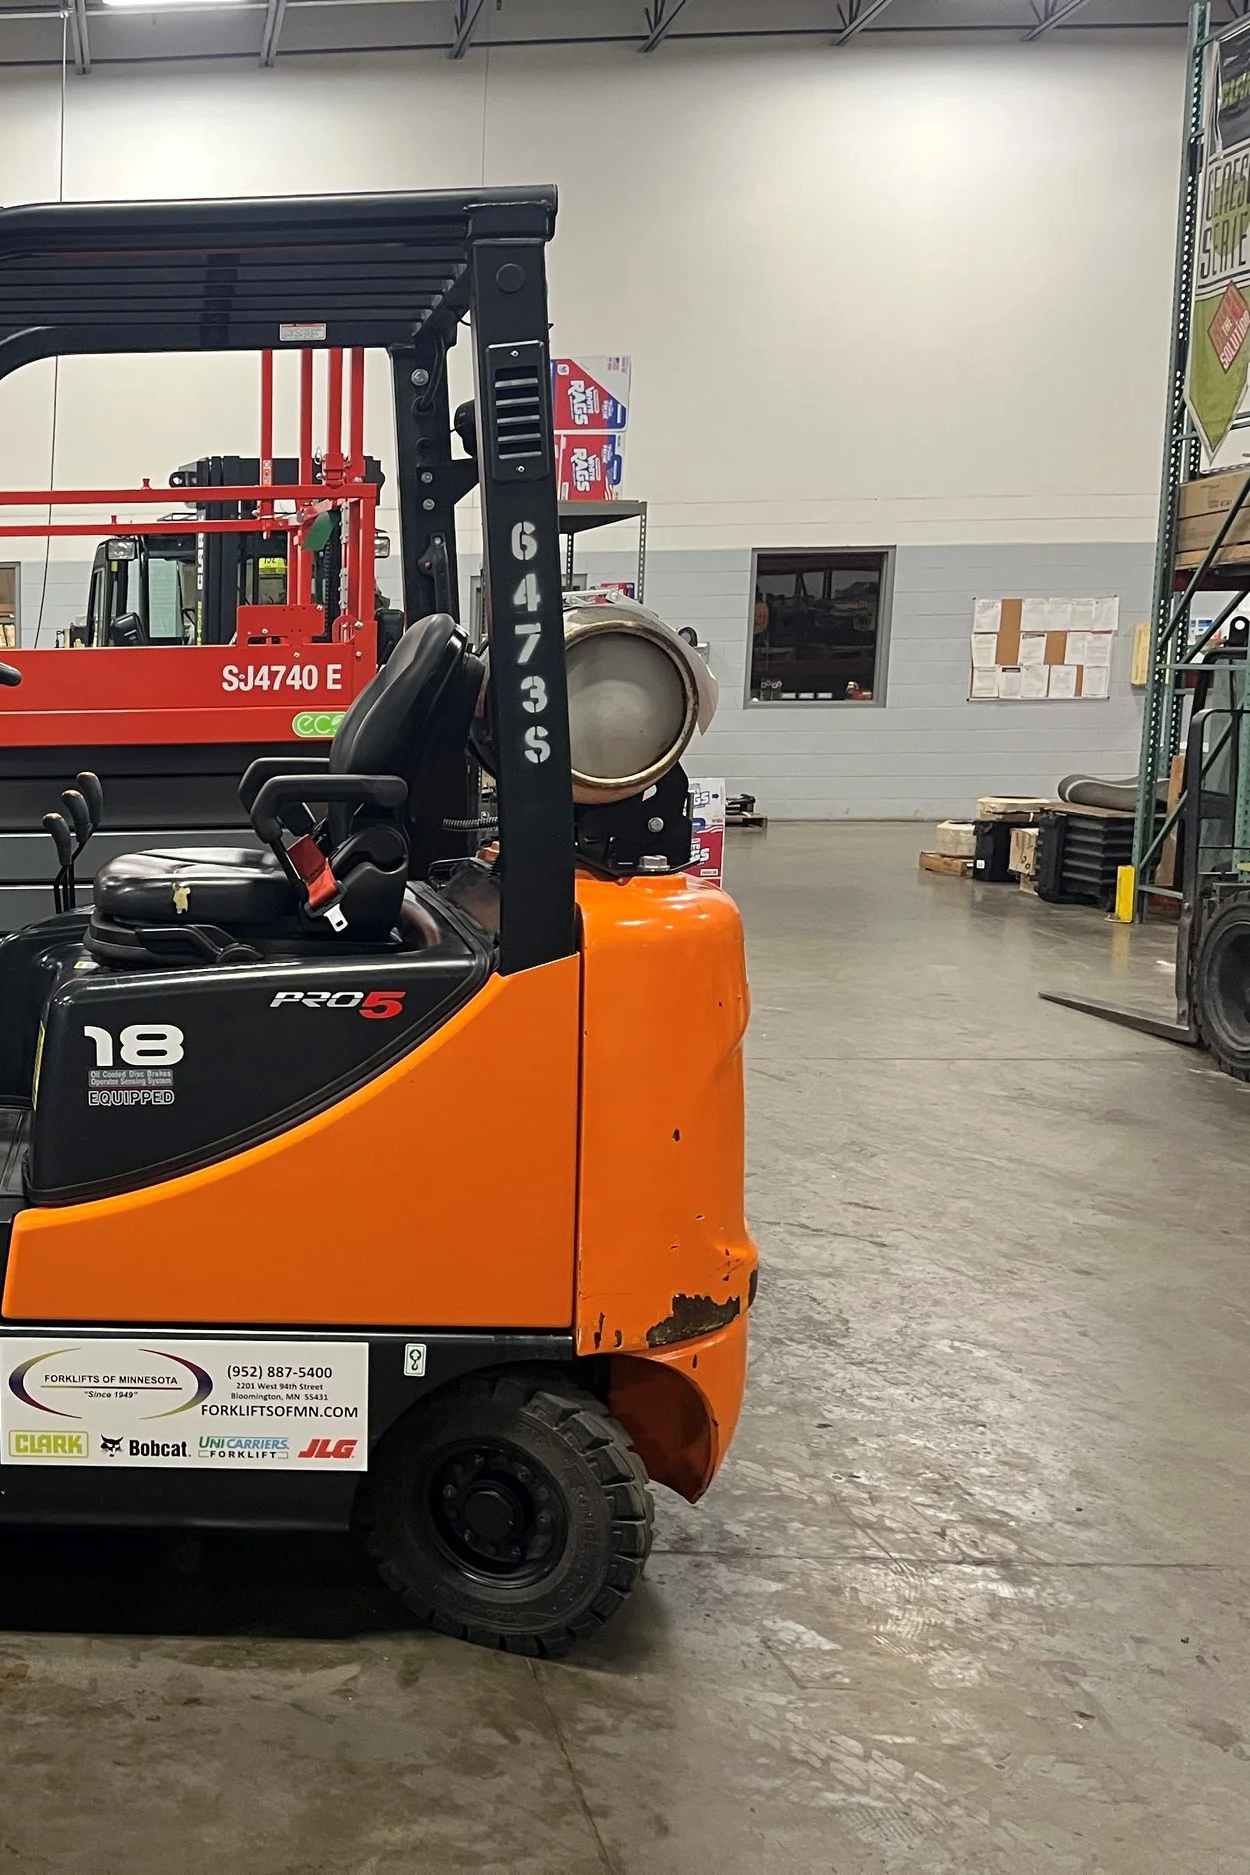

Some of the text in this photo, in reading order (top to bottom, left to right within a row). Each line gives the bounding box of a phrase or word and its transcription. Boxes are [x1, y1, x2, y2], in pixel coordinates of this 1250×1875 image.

[568, 380, 589, 425] RAGS
[571, 448, 591, 492] RAGS
[222, 664, 342, 691] SJ4740 E
[84, 1024, 184, 1066] 18
[90, 1069, 172, 1078] Oil Cooled Disc Brakes
[90, 1078, 172, 1087] Operator Sensing System
[88, 1090, 175, 1106] EQUIPPED
[44, 1374, 178, 1385] FORKLIFTS OF MINNESOTA
[227, 1365, 333, 1379] (952) 887-5400
[236, 1382, 256, 1390] 2201
[279, 1382, 298, 1390] 94th
[299, 1382, 324, 1391] Street
[231, 1392, 284, 1401] Bloomington,
[304, 1393, 328, 1401] 55431
[201, 1404, 358, 1418] FORKLIFTSOFMN.COM
[15, 1434, 82, 1454] CLARK
[129, 1439, 187, 1457] Bobcat
[297, 1439, 358, 1459] JLG
[210, 1450, 277, 1459] FORKLIFT
